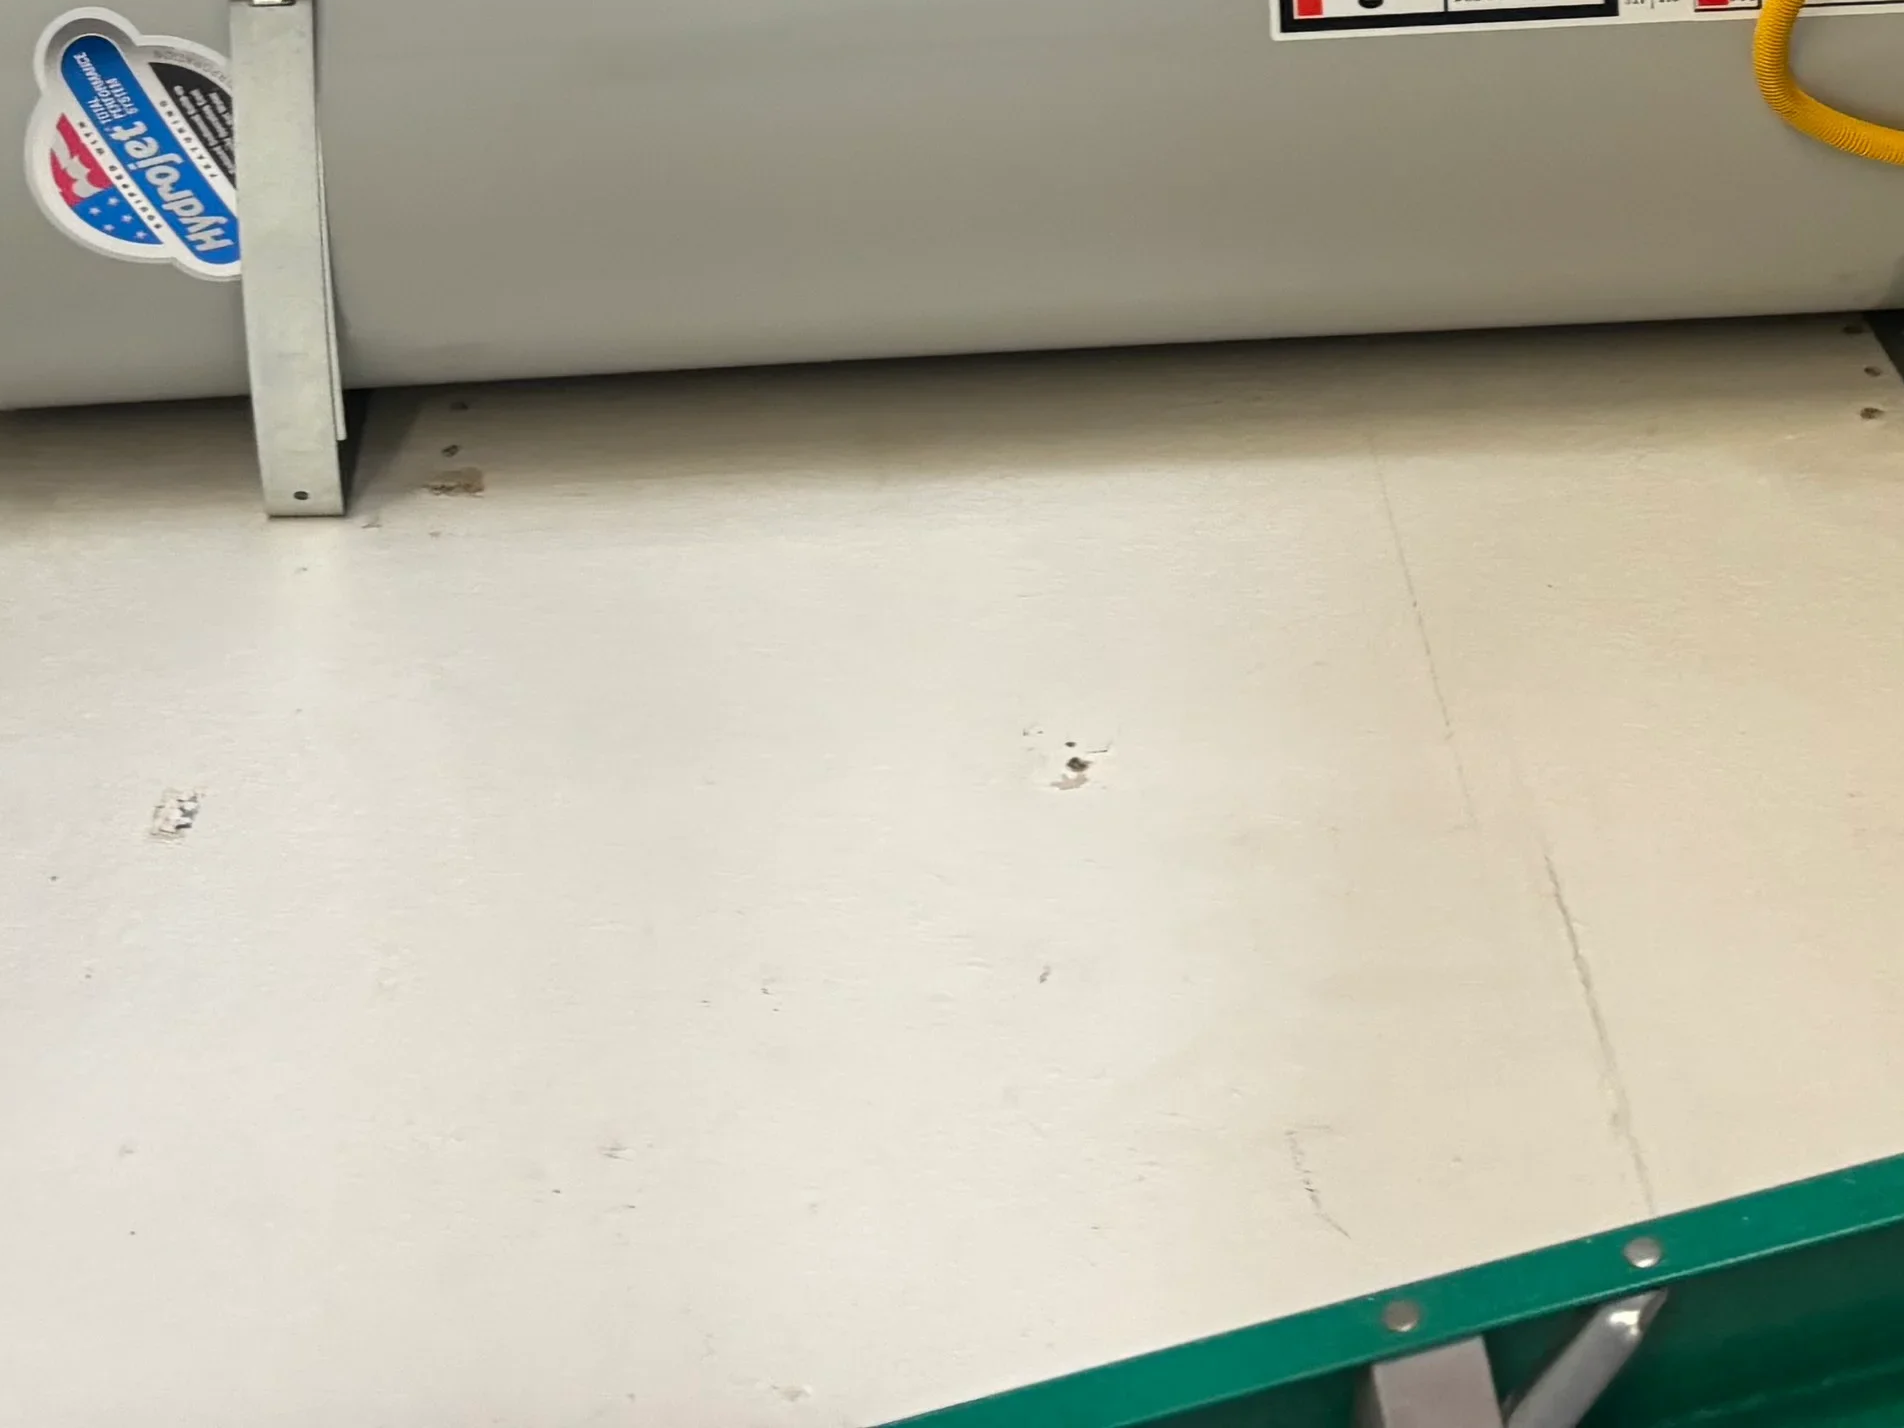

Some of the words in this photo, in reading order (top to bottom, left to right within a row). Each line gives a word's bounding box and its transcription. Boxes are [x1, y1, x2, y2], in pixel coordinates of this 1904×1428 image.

[86, 96, 112, 124] TOTAL
[105, 77, 140, 114] SYSTEM
[78, 120, 105, 156] WITH
[108, 120, 234, 251] Hydrojet
